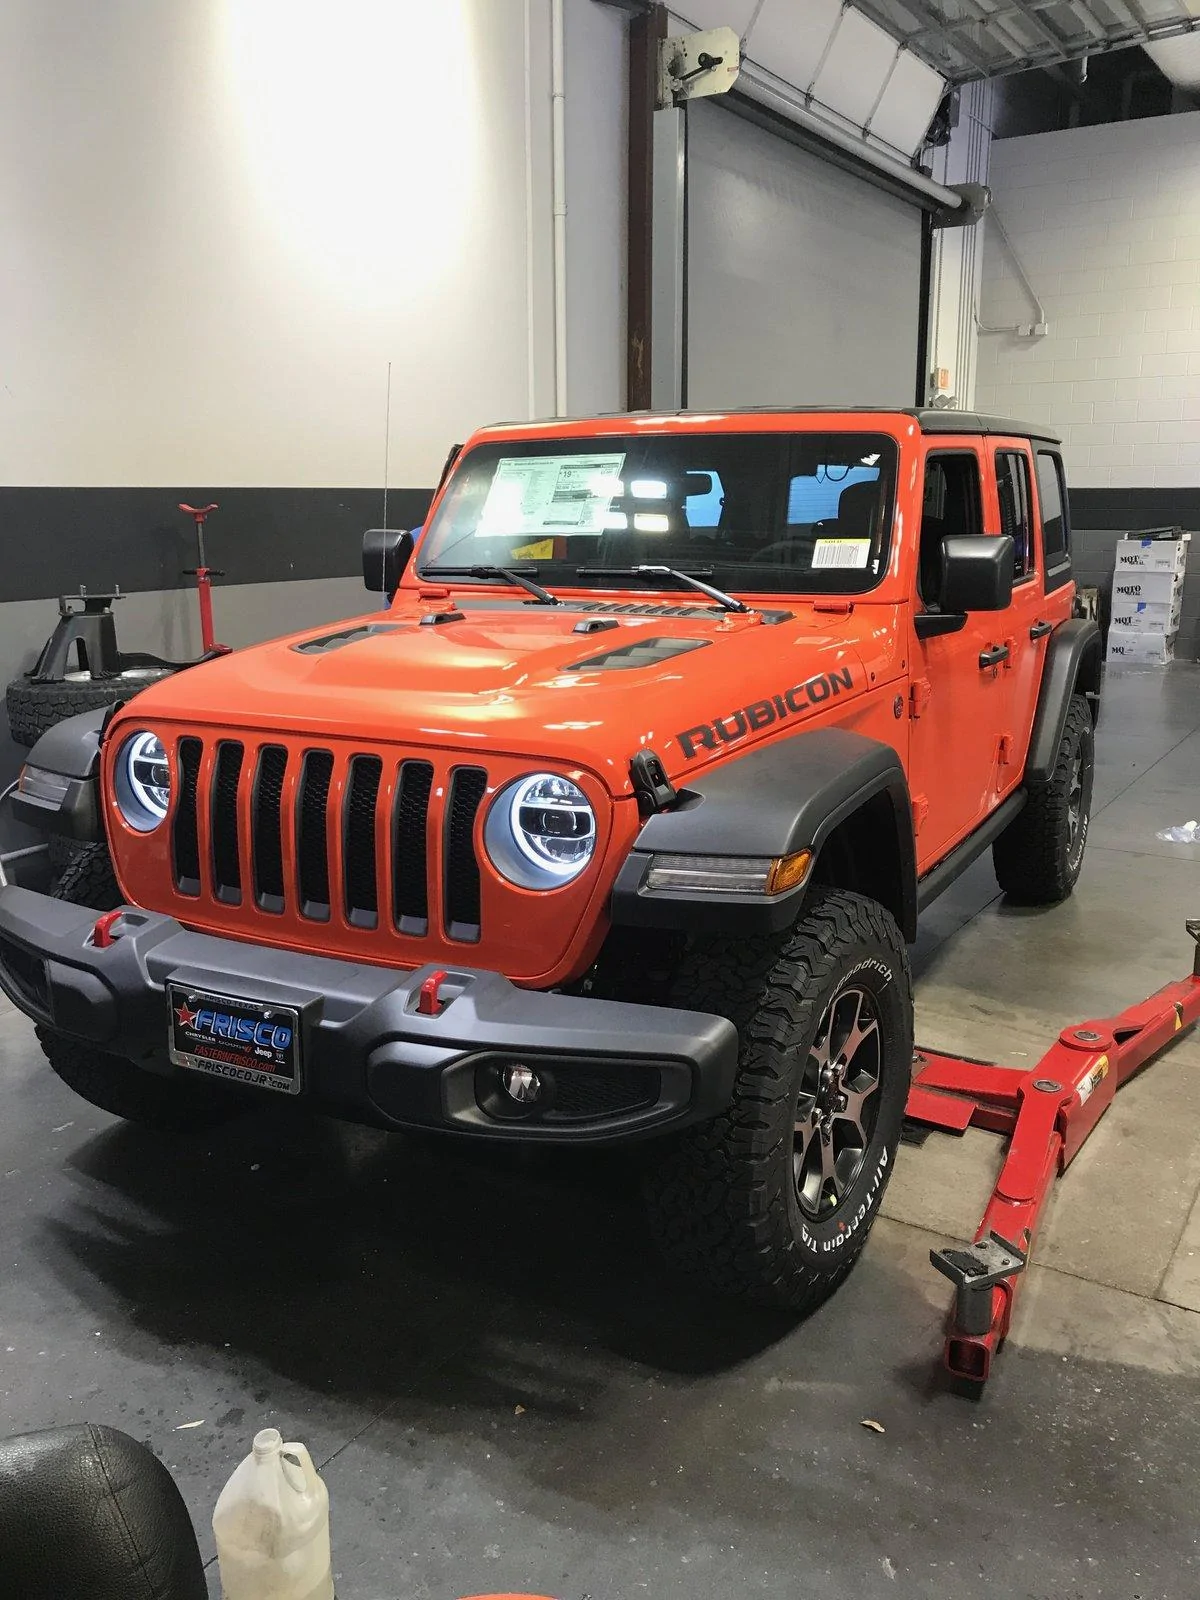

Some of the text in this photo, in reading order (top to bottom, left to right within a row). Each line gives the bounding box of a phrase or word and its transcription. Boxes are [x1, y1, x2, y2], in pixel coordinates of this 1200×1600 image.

[676, 666, 854, 760] RUBICON
[185, 1031, 217, 1042] CHRYSLER
[254, 1047, 273, 1059] Jeep
[194, 1008, 292, 1050] FRISCO
[823, 1145, 889, 1253] All-Terrain
[801, 1223, 818, 1254] T/A
